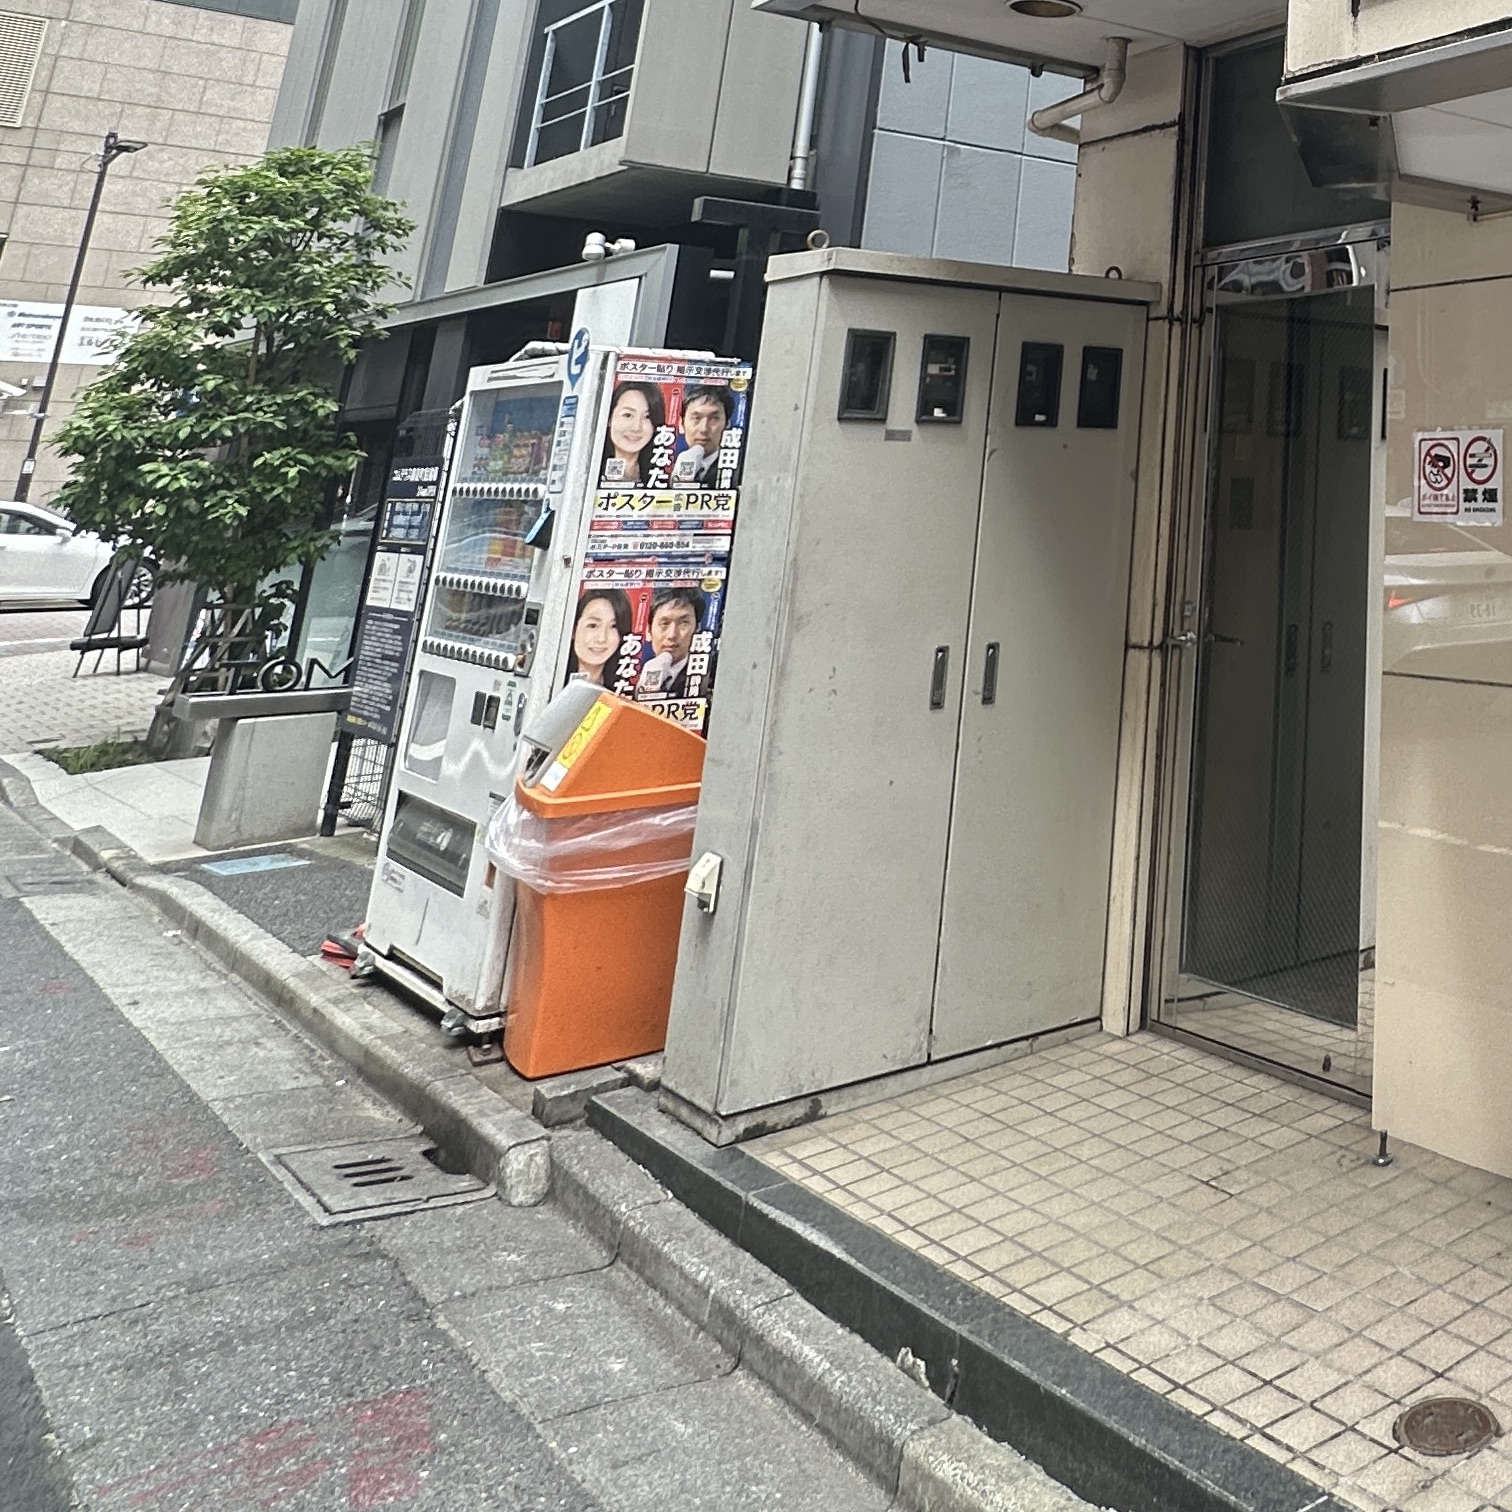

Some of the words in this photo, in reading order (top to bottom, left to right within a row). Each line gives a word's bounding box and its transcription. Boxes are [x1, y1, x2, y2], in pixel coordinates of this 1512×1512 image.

[646, 425, 676, 489] あなた
[685, 492, 732, 512] PR党
[613, 633, 642, 701] あなた
